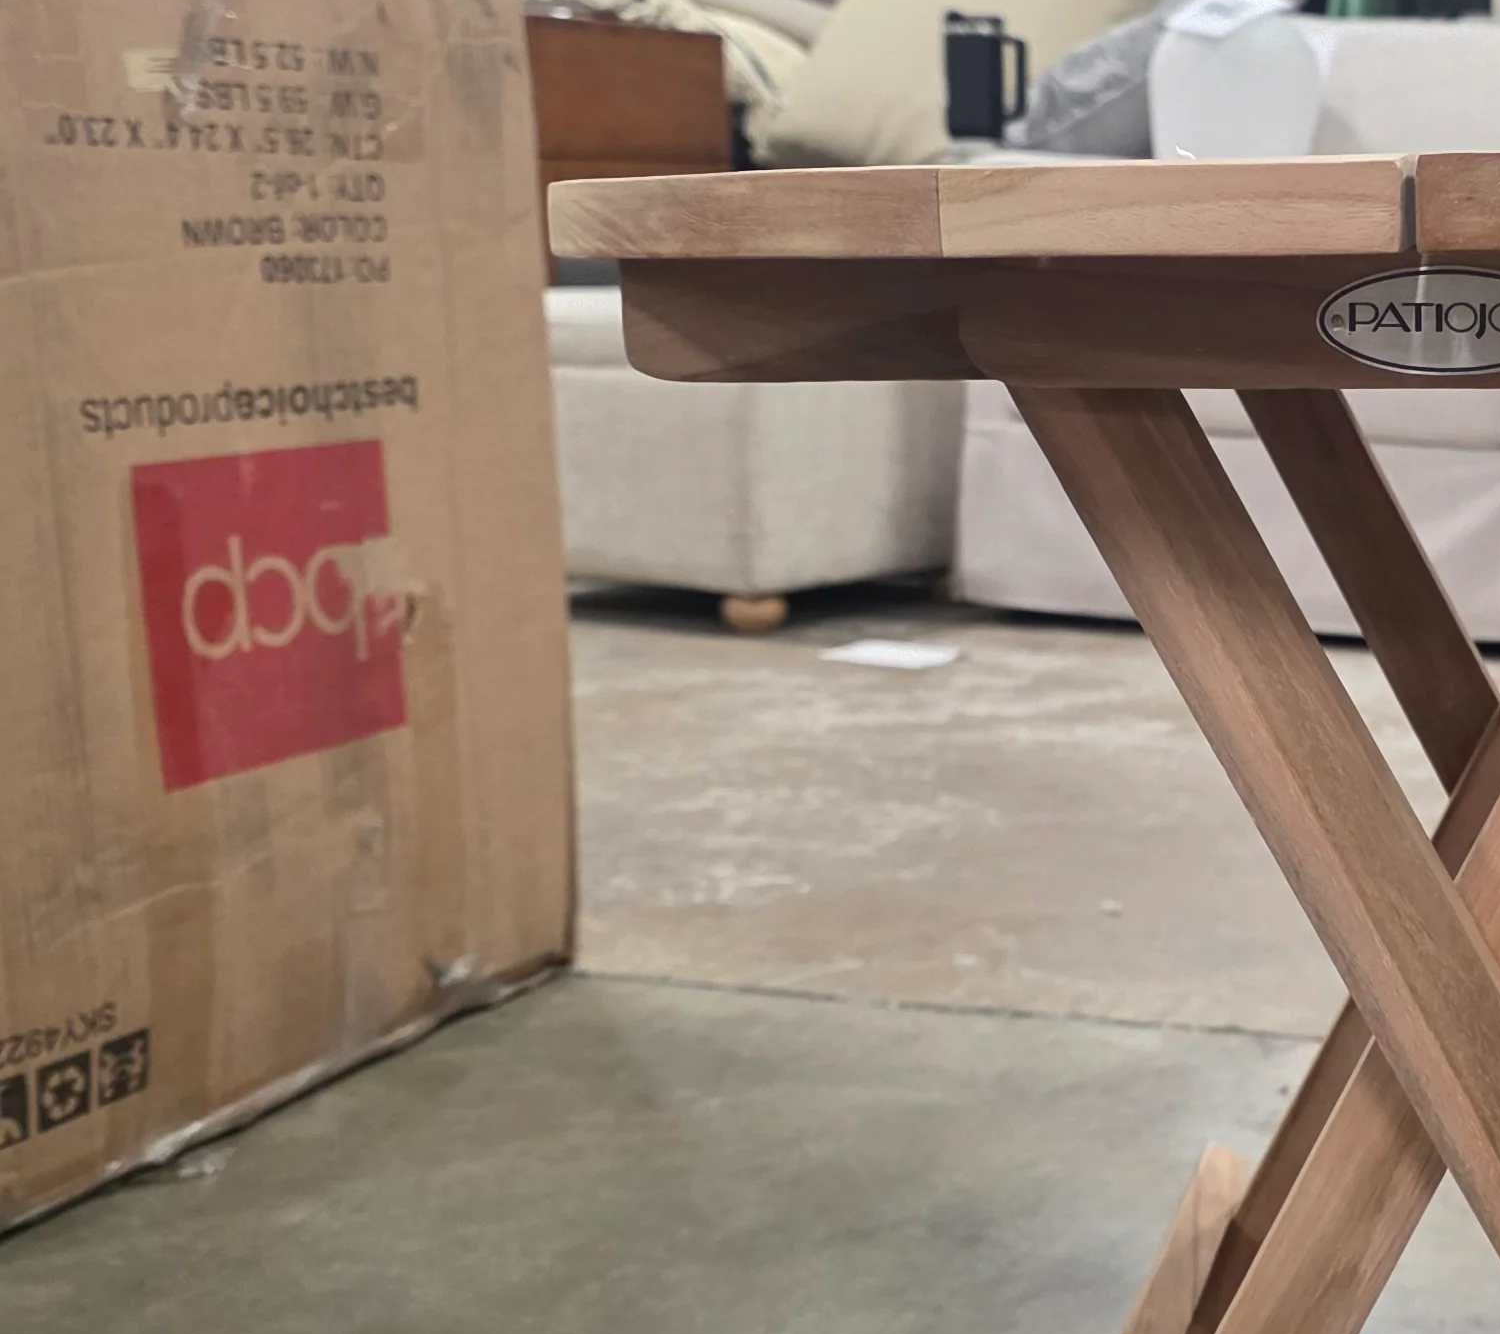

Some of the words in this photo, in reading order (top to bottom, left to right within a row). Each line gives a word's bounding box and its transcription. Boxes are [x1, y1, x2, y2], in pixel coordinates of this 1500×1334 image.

[196, 80, 249, 110] LBS
[181, 216, 285, 248] BROWN
[293, 215, 387, 243] COLOR:
[79, 374, 419, 441] bestchoiceproducts
[181, 532, 370, 662] bcp
